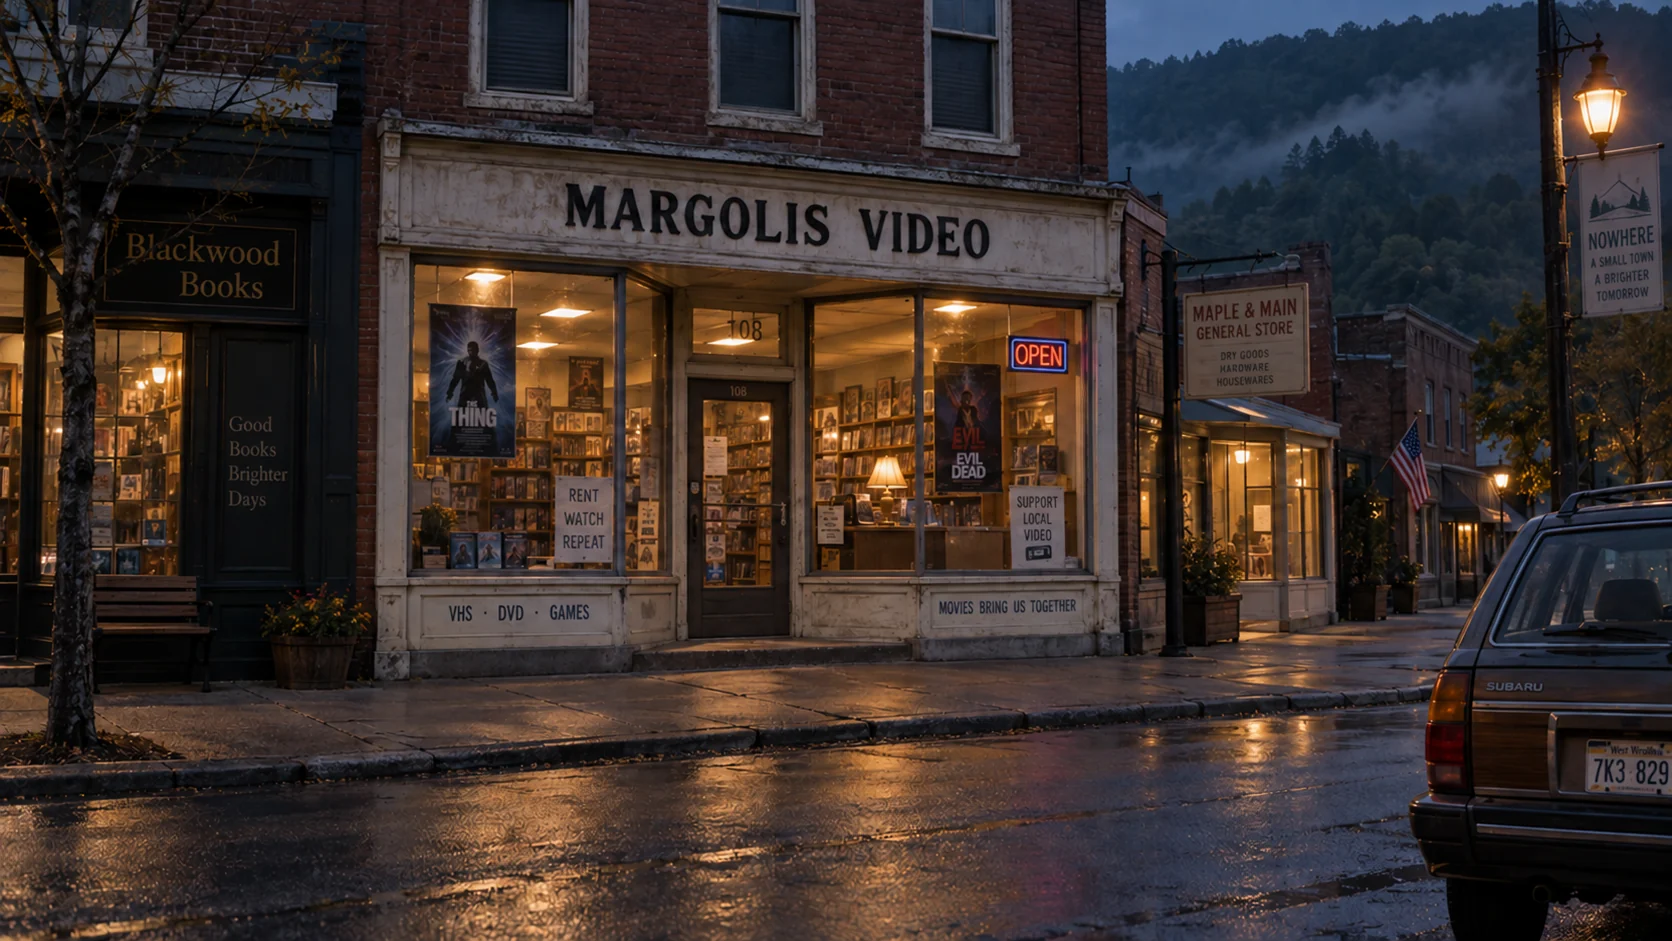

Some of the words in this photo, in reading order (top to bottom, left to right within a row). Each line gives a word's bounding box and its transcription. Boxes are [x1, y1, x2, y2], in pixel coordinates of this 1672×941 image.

[565, 183, 830, 247] MARGOLIS
[858, 208, 990, 259] VIDEO
[1589, 225, 1655, 251] NOWHERE
[126, 232, 280, 267] Blackwood
[1591, 258, 1597, 269] A
[1600, 254, 1627, 268] SMALL
[1630, 251, 1654, 265] TOWN
[179, 271, 264, 300] Books
[1595, 274, 1601, 285] A
[1604, 269, 1649, 284] BRIGHTER
[1596, 286, 1649, 302] TOMORROW
[1193, 303, 1240, 322] MAPLE
[1244, 302, 1255, 319] &
[1260, 298, 1297, 318] MAIN
[727, 319, 763, 341] 108
[1196, 323, 1251, 341] GENERAL
[1255, 320, 1293, 337] STORE
[1015, 343, 1063, 367] OPEN
[1220, 351, 1236, 361] DRY
[1240, 349, 1270, 360] GOODS
[1220, 362, 1269, 374] HARDWARE
[1216, 375, 1274, 387] HOUSEWARES
[730, 385, 748, 397] 108
[229, 415, 273, 434] Good
[448, 407, 497, 428] THING
[229, 440, 277, 458] Books
[956, 452, 984, 465] EVIL
[228, 465, 288, 486] Brighter
[951, 465, 986, 479] DEAD
[228, 490, 267, 511] Days
[569, 488, 599, 503] RENT
[1016, 496, 1058, 509] SUPPORT
[564, 511, 604, 526] WATCH
[1023, 512, 1052, 525] LOCAL
[563, 534, 605, 549] REPEAT
[1024, 529, 1052, 541] VIDEO
[449, 605, 473, 622] VHS
[497, 604, 524, 621] DVD
[549, 604, 590, 621] GAMES
[939, 600, 974, 615] MOVIES
[979, 600, 1008, 614] BRING
[1013, 600, 1026, 613] US
[1031, 599, 1077, 613] TOGETHER
[1486, 682, 1544, 692] SUBARU
[1593, 758, 1626, 783] 7K3
[1636, 760, 1669, 785] 829
